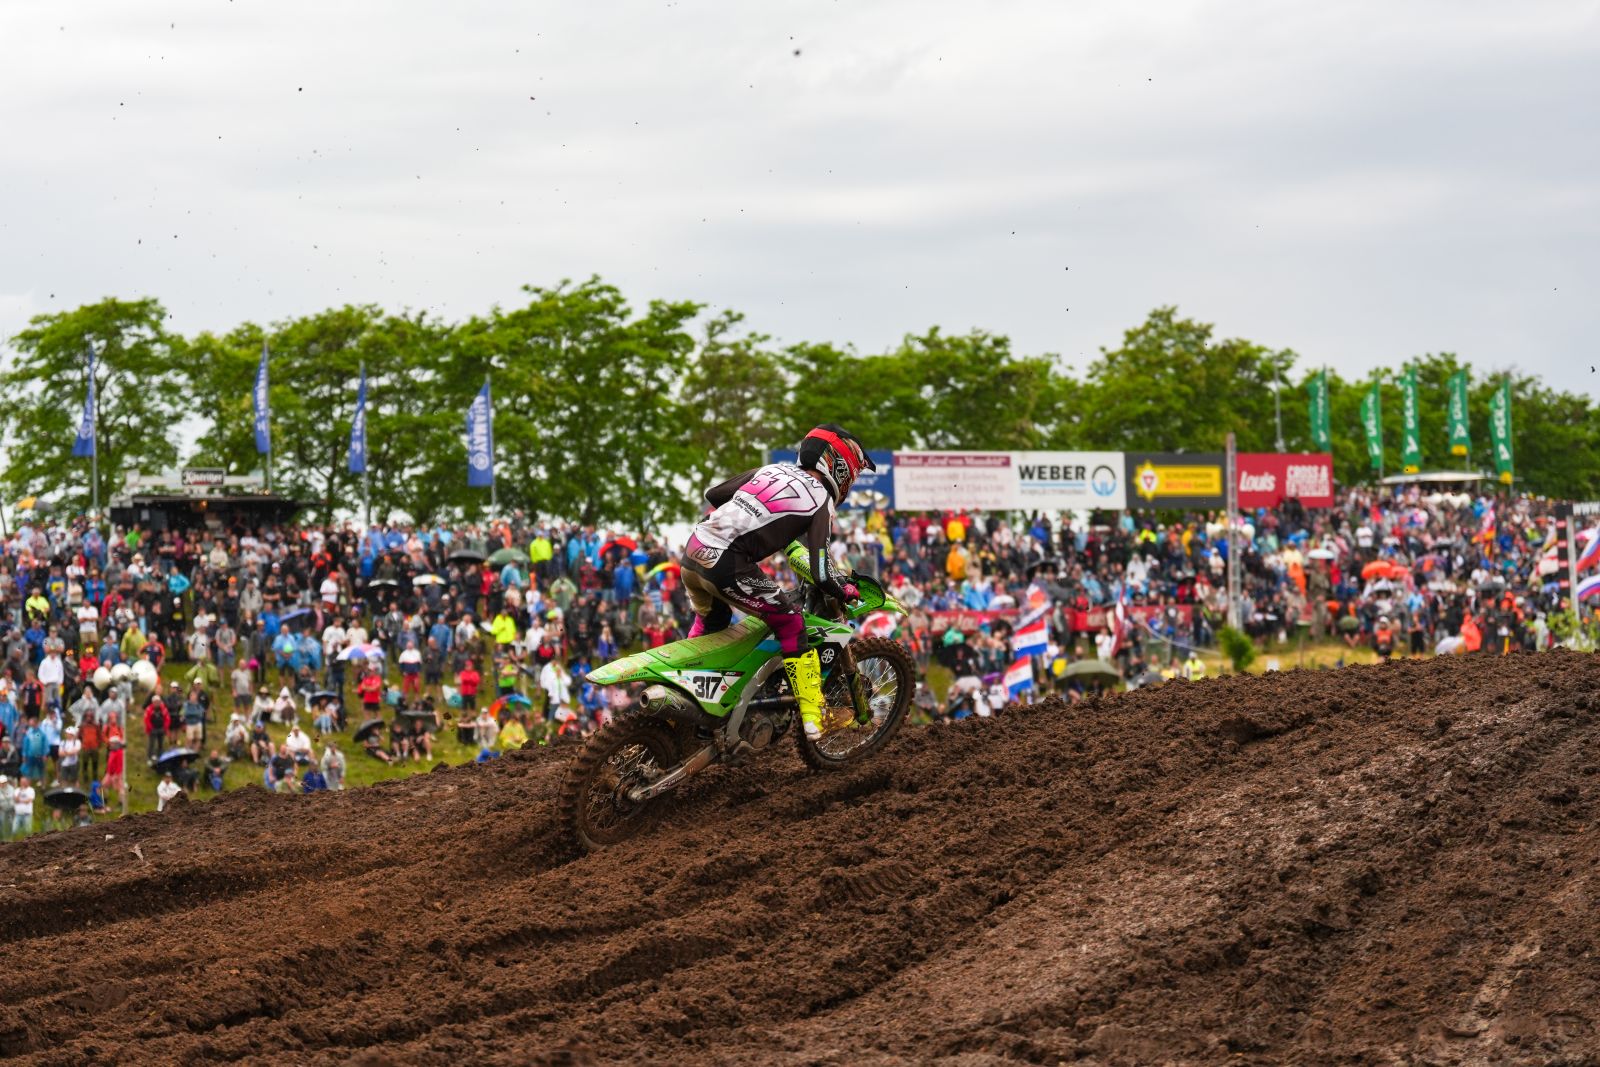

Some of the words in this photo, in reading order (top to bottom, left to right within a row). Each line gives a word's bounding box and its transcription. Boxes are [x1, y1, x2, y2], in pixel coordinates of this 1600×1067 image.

[1018, 465, 1086, 480] WEBER
[1239, 471, 1277, 492] Louis
[738, 465, 818, 514] 317
[722, 586, 764, 609] Kawasaki
[693, 676, 722, 700] 317
